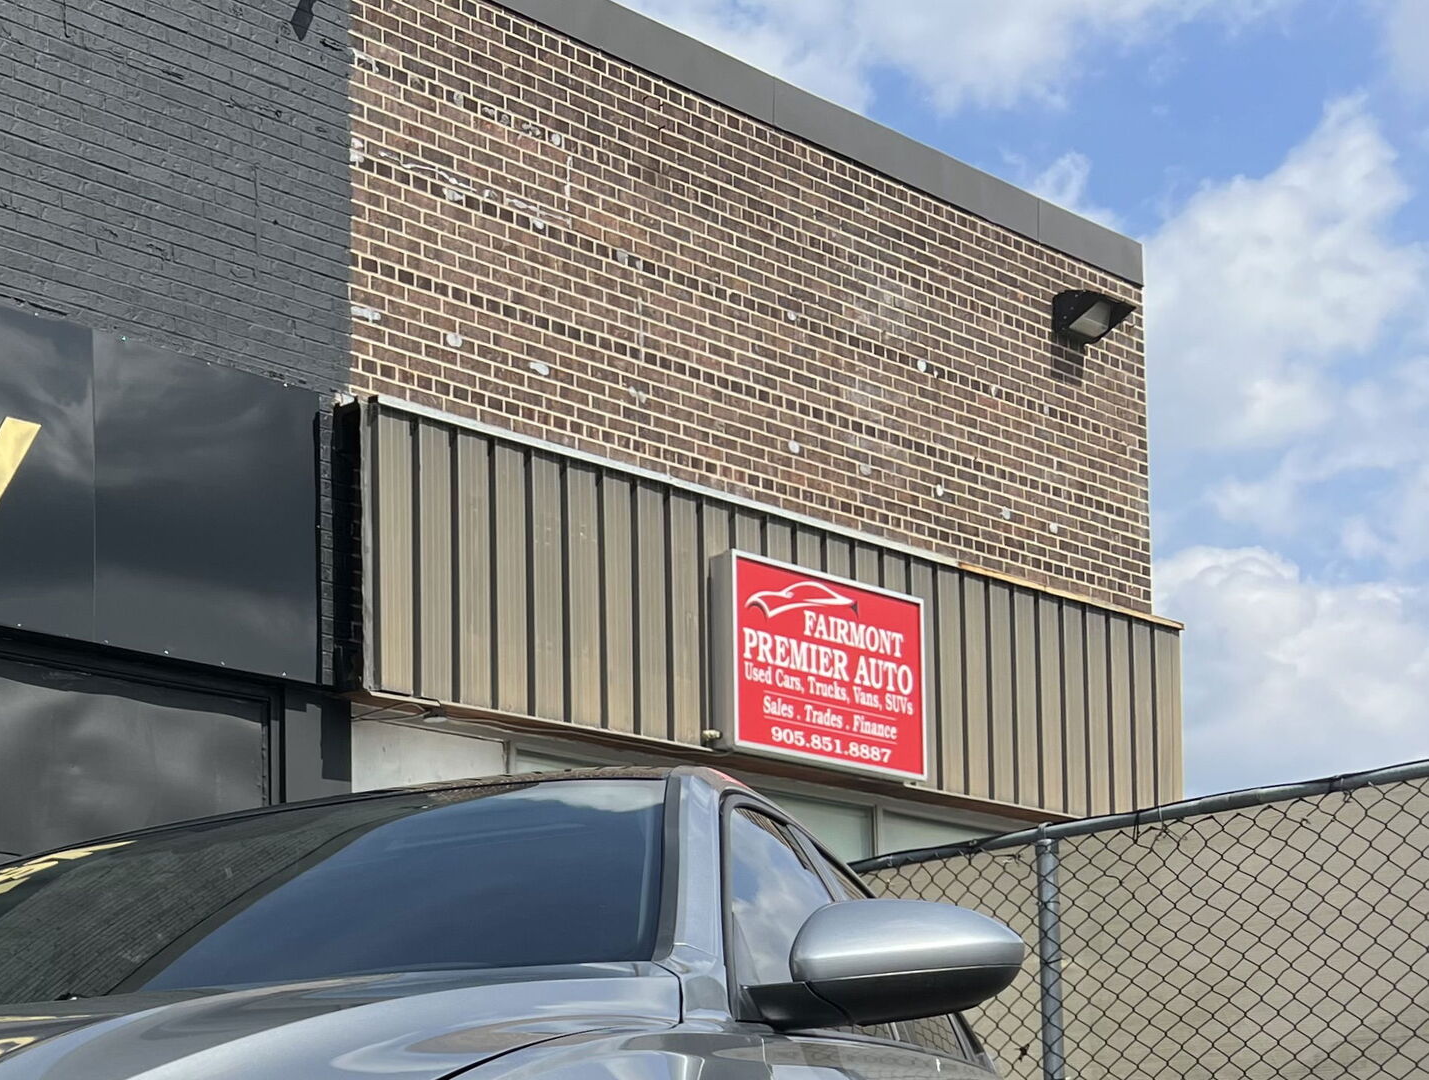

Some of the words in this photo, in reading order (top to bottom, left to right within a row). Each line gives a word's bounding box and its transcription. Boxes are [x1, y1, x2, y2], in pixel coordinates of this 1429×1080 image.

[803, 610, 904, 658] FAIRMONT
[742, 627, 849, 682] PREMIER
[853, 655, 913, 695] AUTO
[743, 661, 772, 685] Used
[775, 670, 805, 694] Cars,
[807, 676, 850, 704] Trucks,
[853, 686, 883, 711] Vans,
[885, 693, 914, 716] SUVs
[763, 695, 794, 719] Sales
[804, 705, 843, 729] Trades
[853, 715, 898, 740] Finance
[771, 726, 892, 763] 905.851.8887
